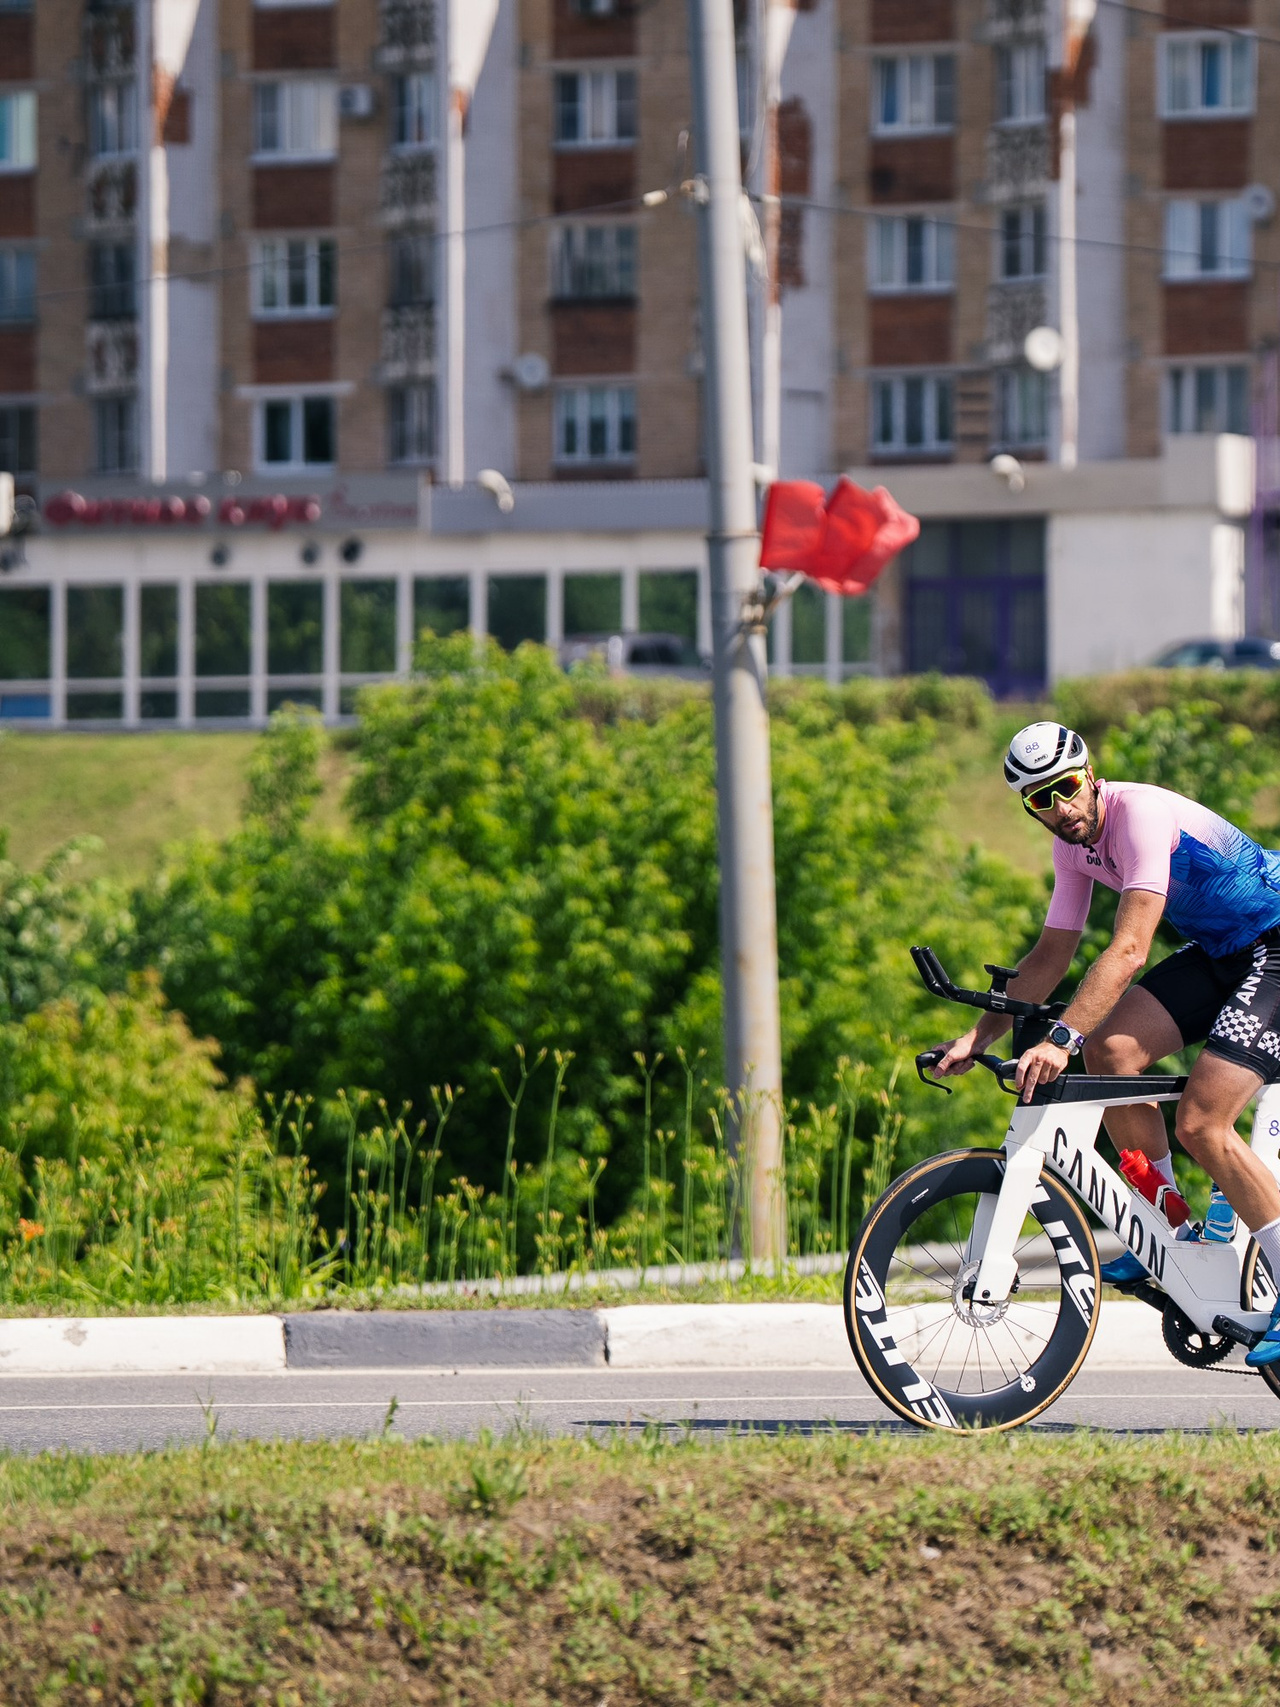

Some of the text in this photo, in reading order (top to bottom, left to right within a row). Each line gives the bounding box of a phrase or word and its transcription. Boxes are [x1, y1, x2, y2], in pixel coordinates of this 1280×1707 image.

[1025, 741, 1040, 754] 88
[1052, 1126, 1166, 1282] CANYON
[855, 1272, 952, 1428] ELITE
